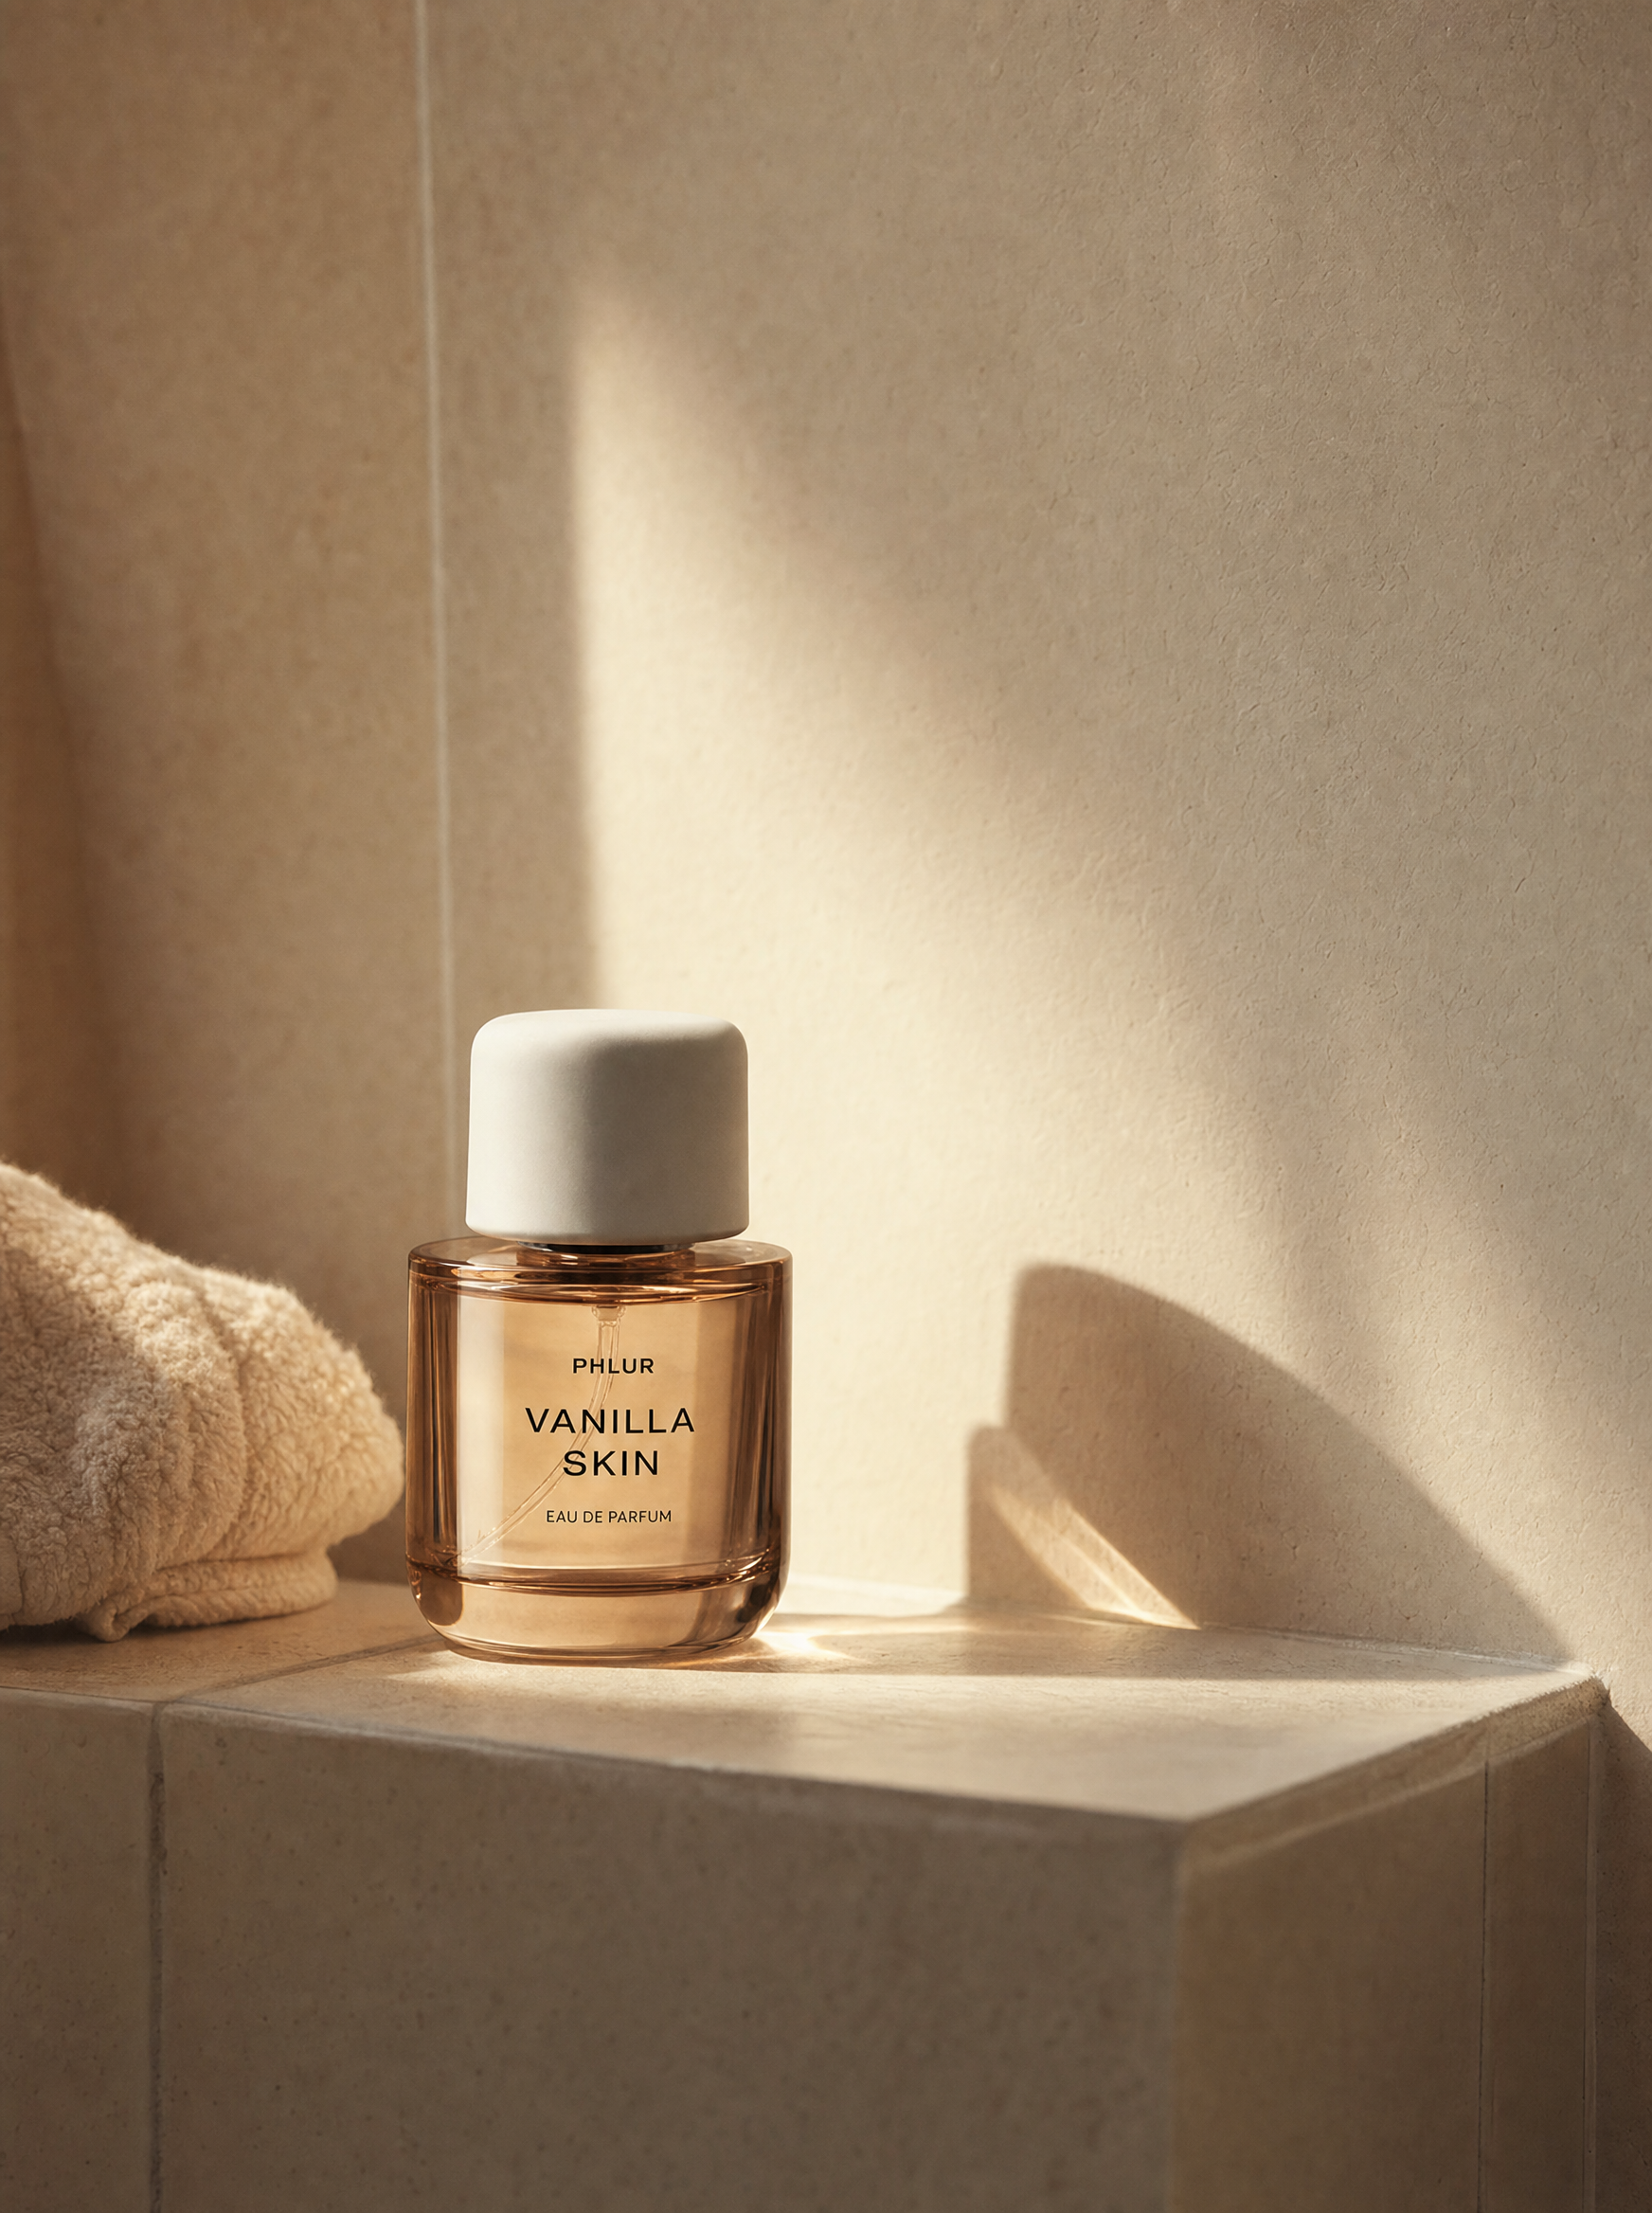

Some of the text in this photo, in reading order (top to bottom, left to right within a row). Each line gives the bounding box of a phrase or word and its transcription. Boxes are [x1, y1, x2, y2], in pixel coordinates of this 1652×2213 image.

[572, 1358, 655, 1375] PHLUR
[525, 1407, 695, 1434] VANILLA
[563, 1449, 658, 1477] SKIN
[547, 1510, 672, 1523] EAU DE PARFUM
